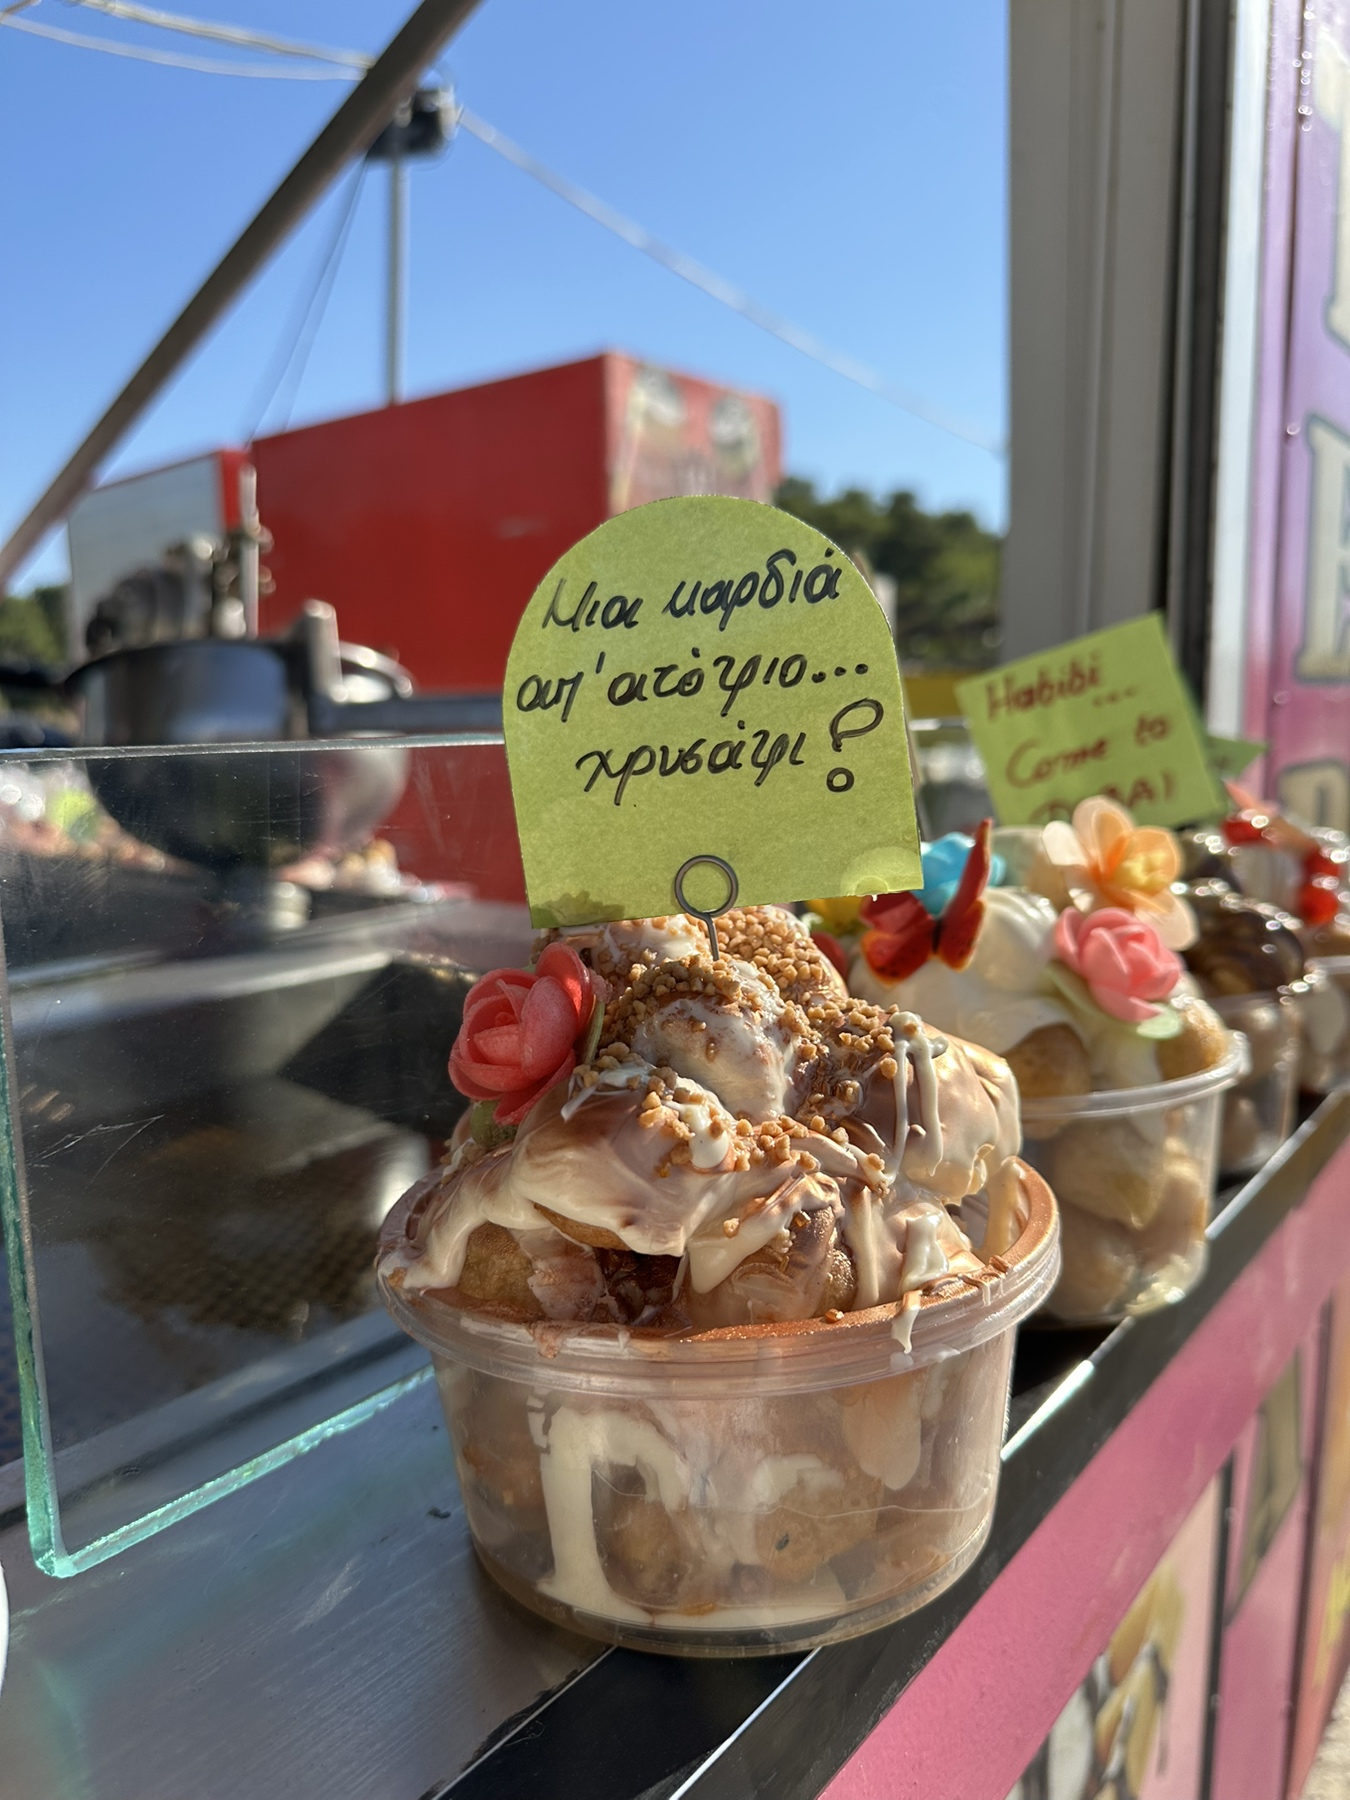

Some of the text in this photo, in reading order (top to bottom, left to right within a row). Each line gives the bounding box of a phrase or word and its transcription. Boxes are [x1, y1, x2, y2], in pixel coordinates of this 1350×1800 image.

[542, 547, 842, 632] Μια καρδιά
[1005, 712, 1171, 789] Come to
